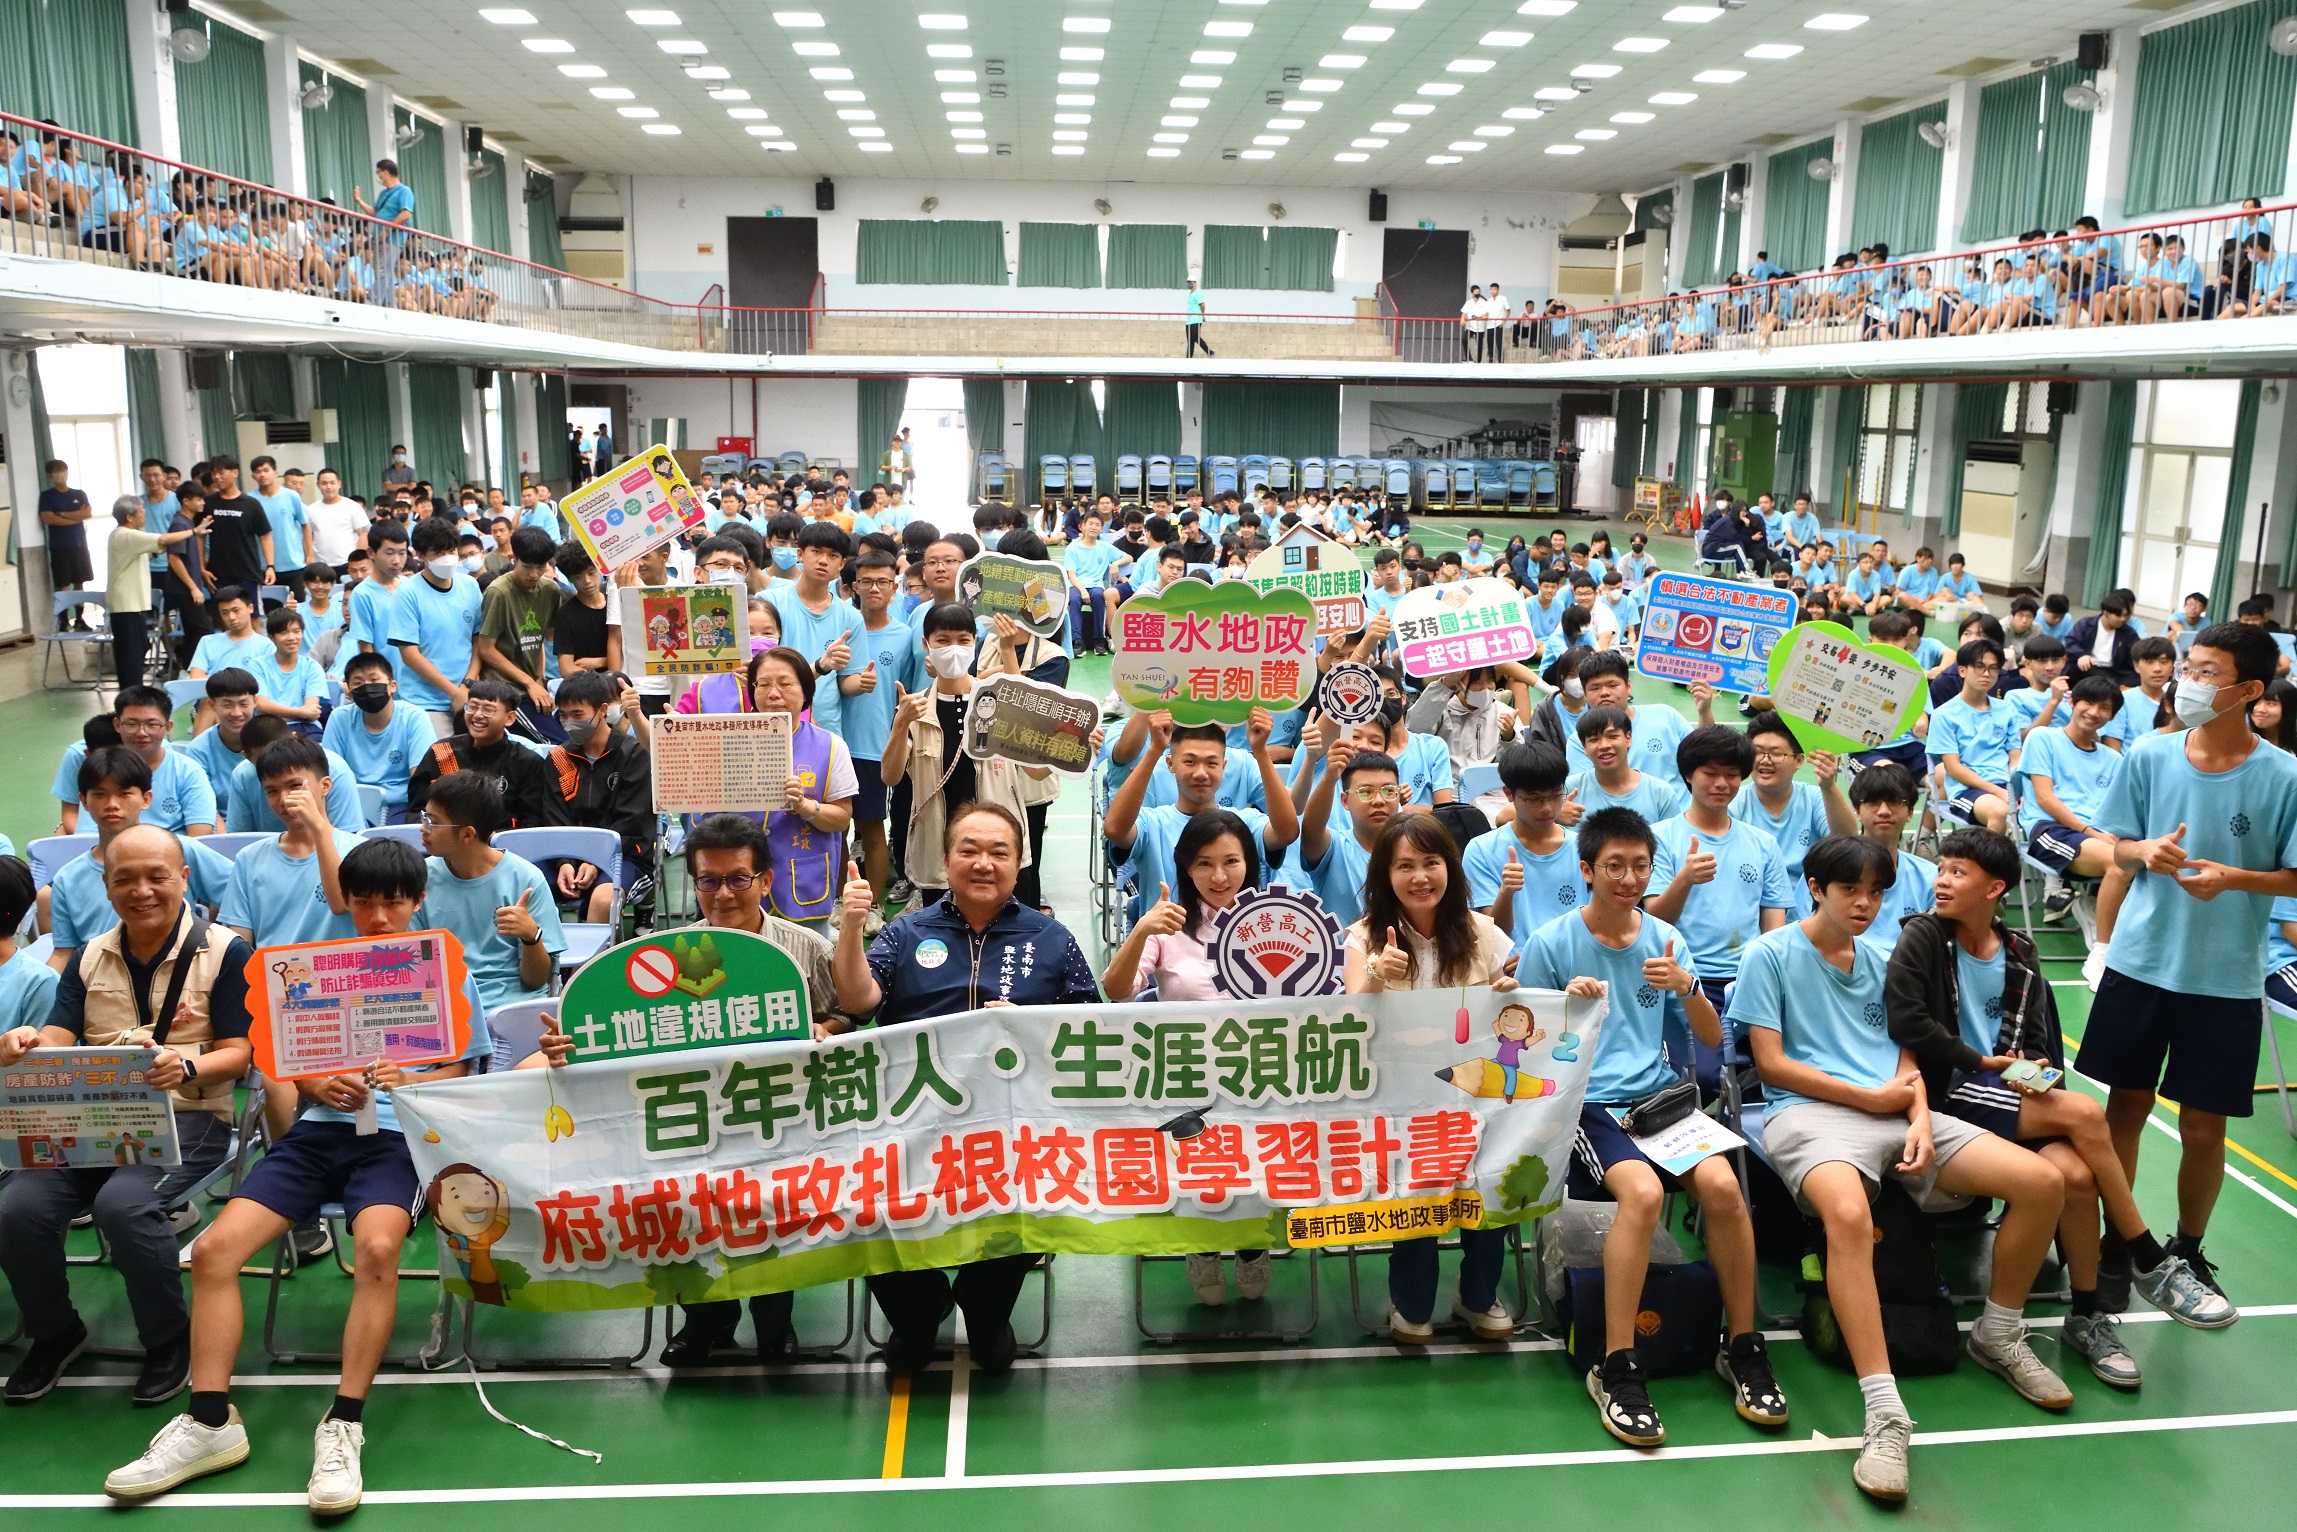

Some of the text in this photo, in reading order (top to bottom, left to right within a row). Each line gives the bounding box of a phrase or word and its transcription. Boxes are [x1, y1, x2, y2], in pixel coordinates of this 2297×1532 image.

[213, 508, 242, 517] BOSTON
[1659, 578, 1790, 614] 慎選合法不動產業者
[1121, 612, 1308, 655] 鹽水地政
[1397, 601, 1523, 642] 支持國土計畫
[656, 663, 719, 673] 全民防詐騙!
[1405, 630, 1531, 669] 一起守護土地
[1120, 672, 1139, 681] YAN
[1188, 659, 1300, 700] 有夠讚
[1334, 675, 1369, 692] 新營高工
[1861, 658, 1898, 681] 步步平安
[996, 683, 1092, 729] 住址隱匿順手辦
[992, 719, 1088, 763] 個人資料有保障
[1236, 912, 1315, 945] 新營高工
[1020, 941, 1036, 979] 臺南市
[573, 988, 800, 1056] 土地違規使用
[535, 1110, 1479, 1266] 府城地政扎根校園學習計畫
